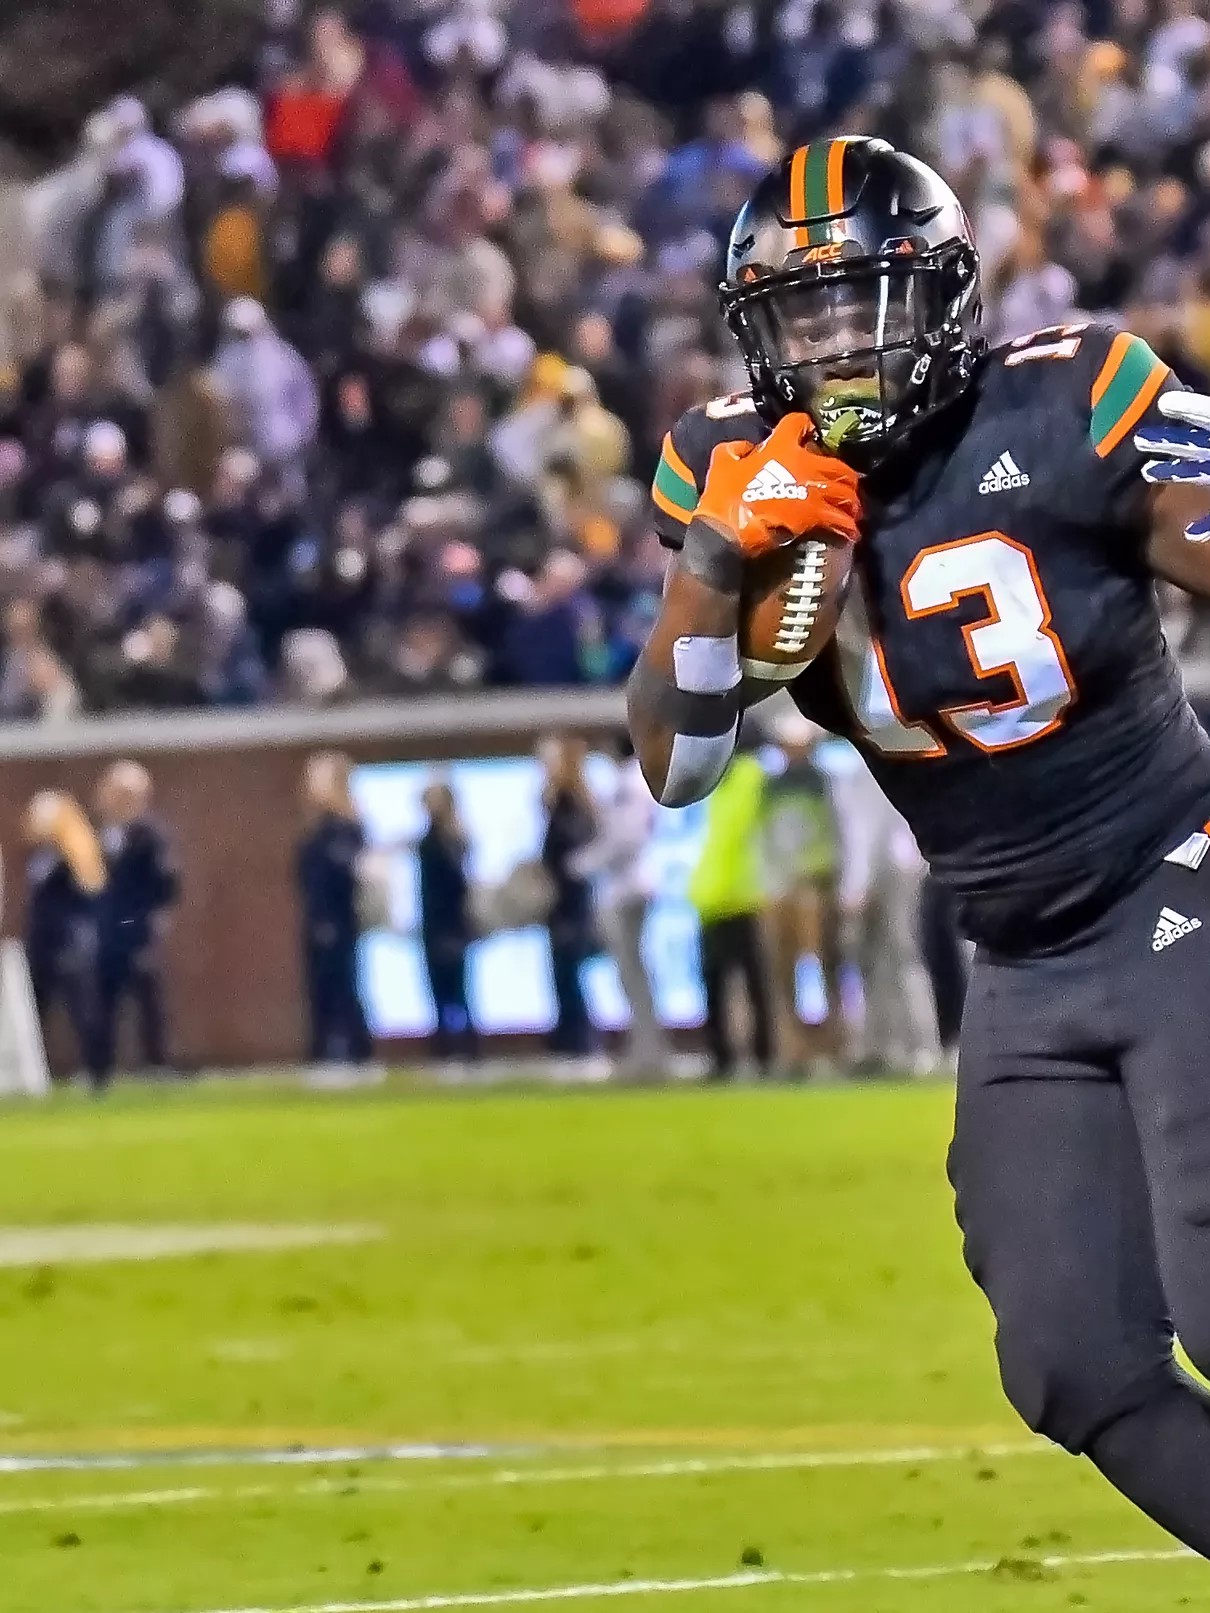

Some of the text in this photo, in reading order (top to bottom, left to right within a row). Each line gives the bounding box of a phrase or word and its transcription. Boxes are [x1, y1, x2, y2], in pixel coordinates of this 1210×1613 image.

[801, 243, 844, 263] ACC
[742, 482, 809, 503] adidas
[979, 473, 1031, 495] adidas
[1152, 917, 1203, 952] adidas
